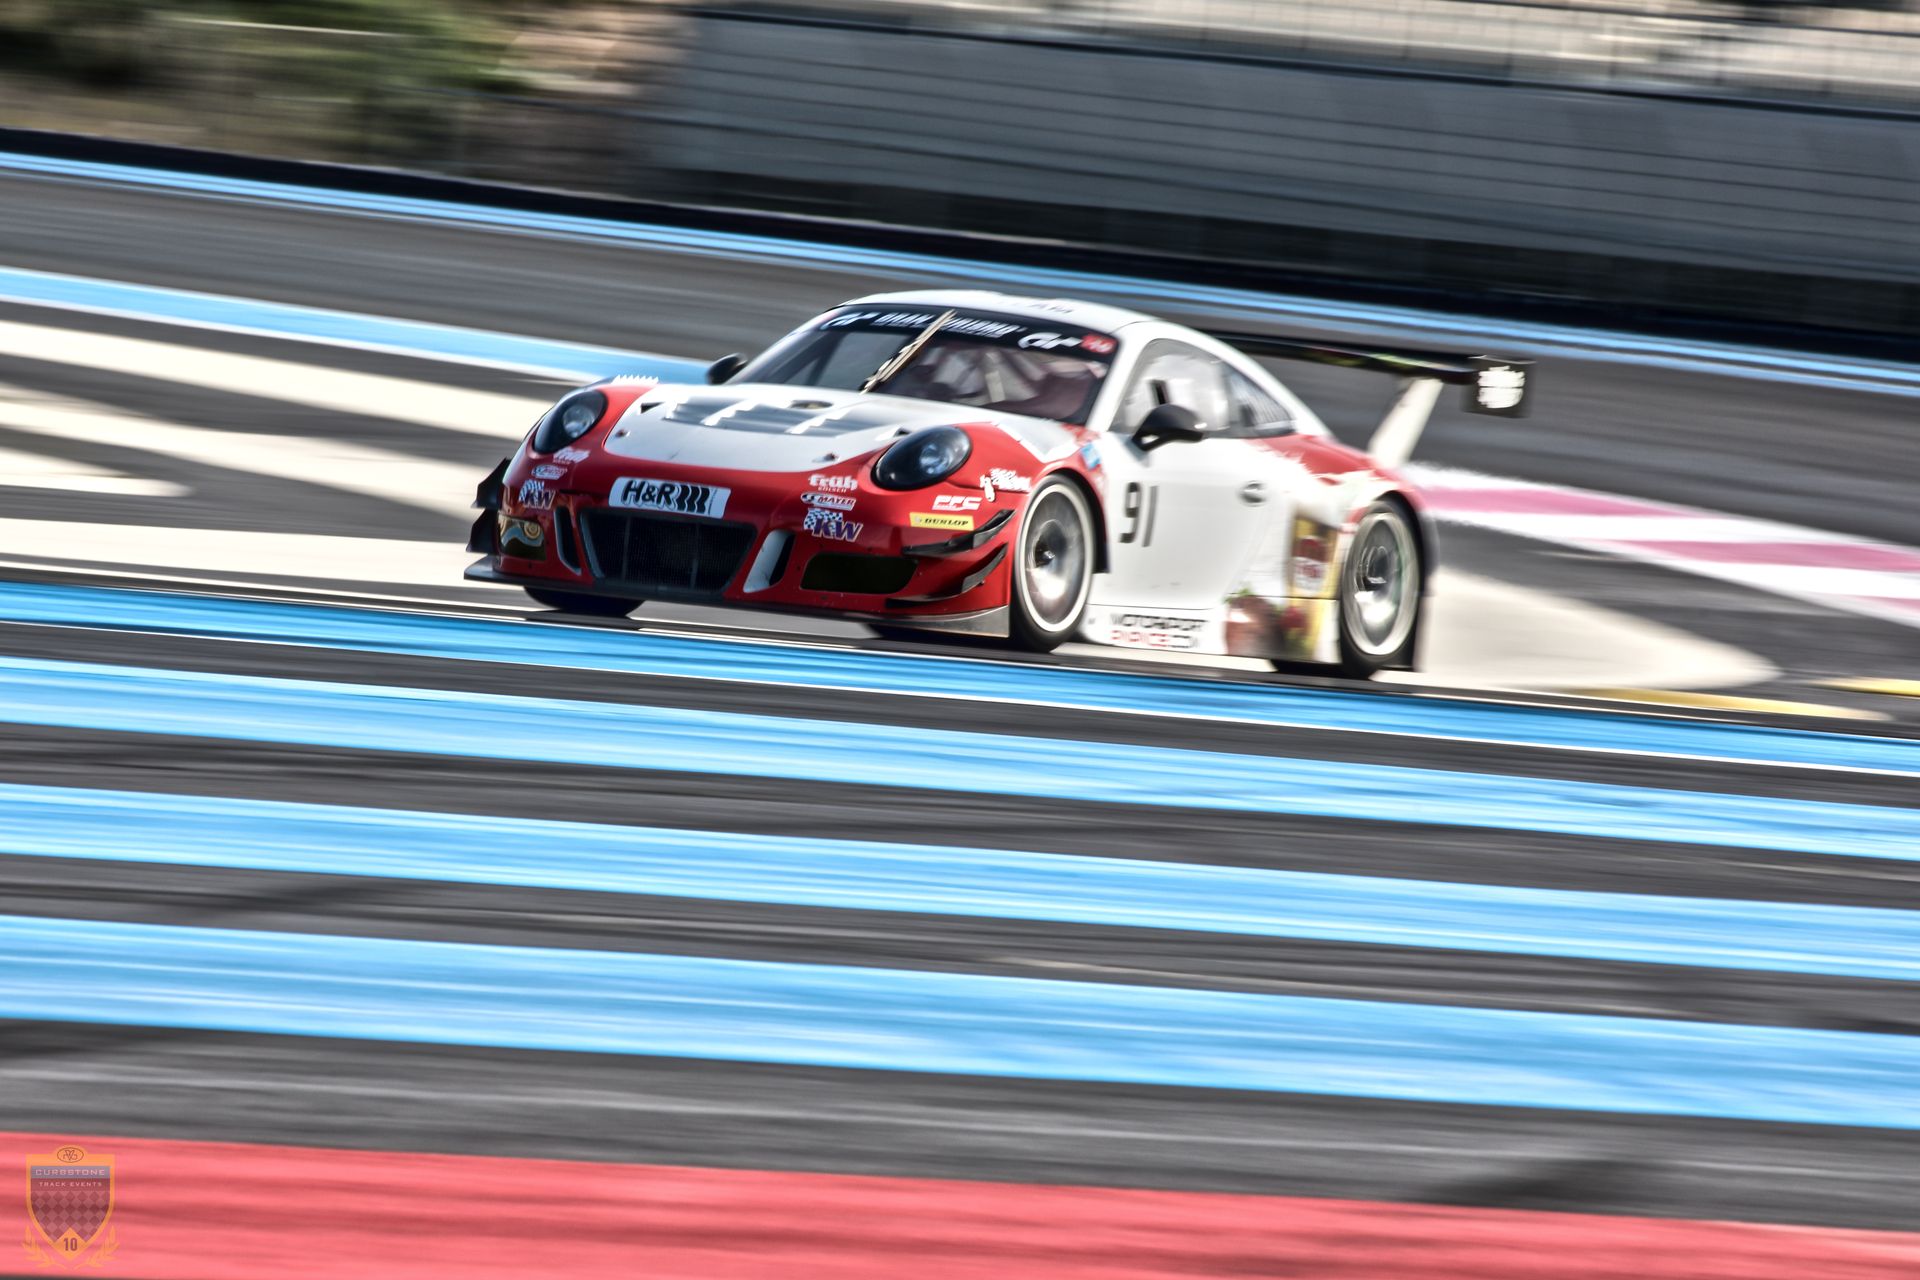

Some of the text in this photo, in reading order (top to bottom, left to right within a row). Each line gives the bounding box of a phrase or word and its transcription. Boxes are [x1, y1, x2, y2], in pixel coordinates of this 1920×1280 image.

[621, 479, 676, 508] H&R
[924, 517, 968, 526] DUNLOP
[1118, 481, 1160, 548] 91
[812, 518, 863, 542] KW
